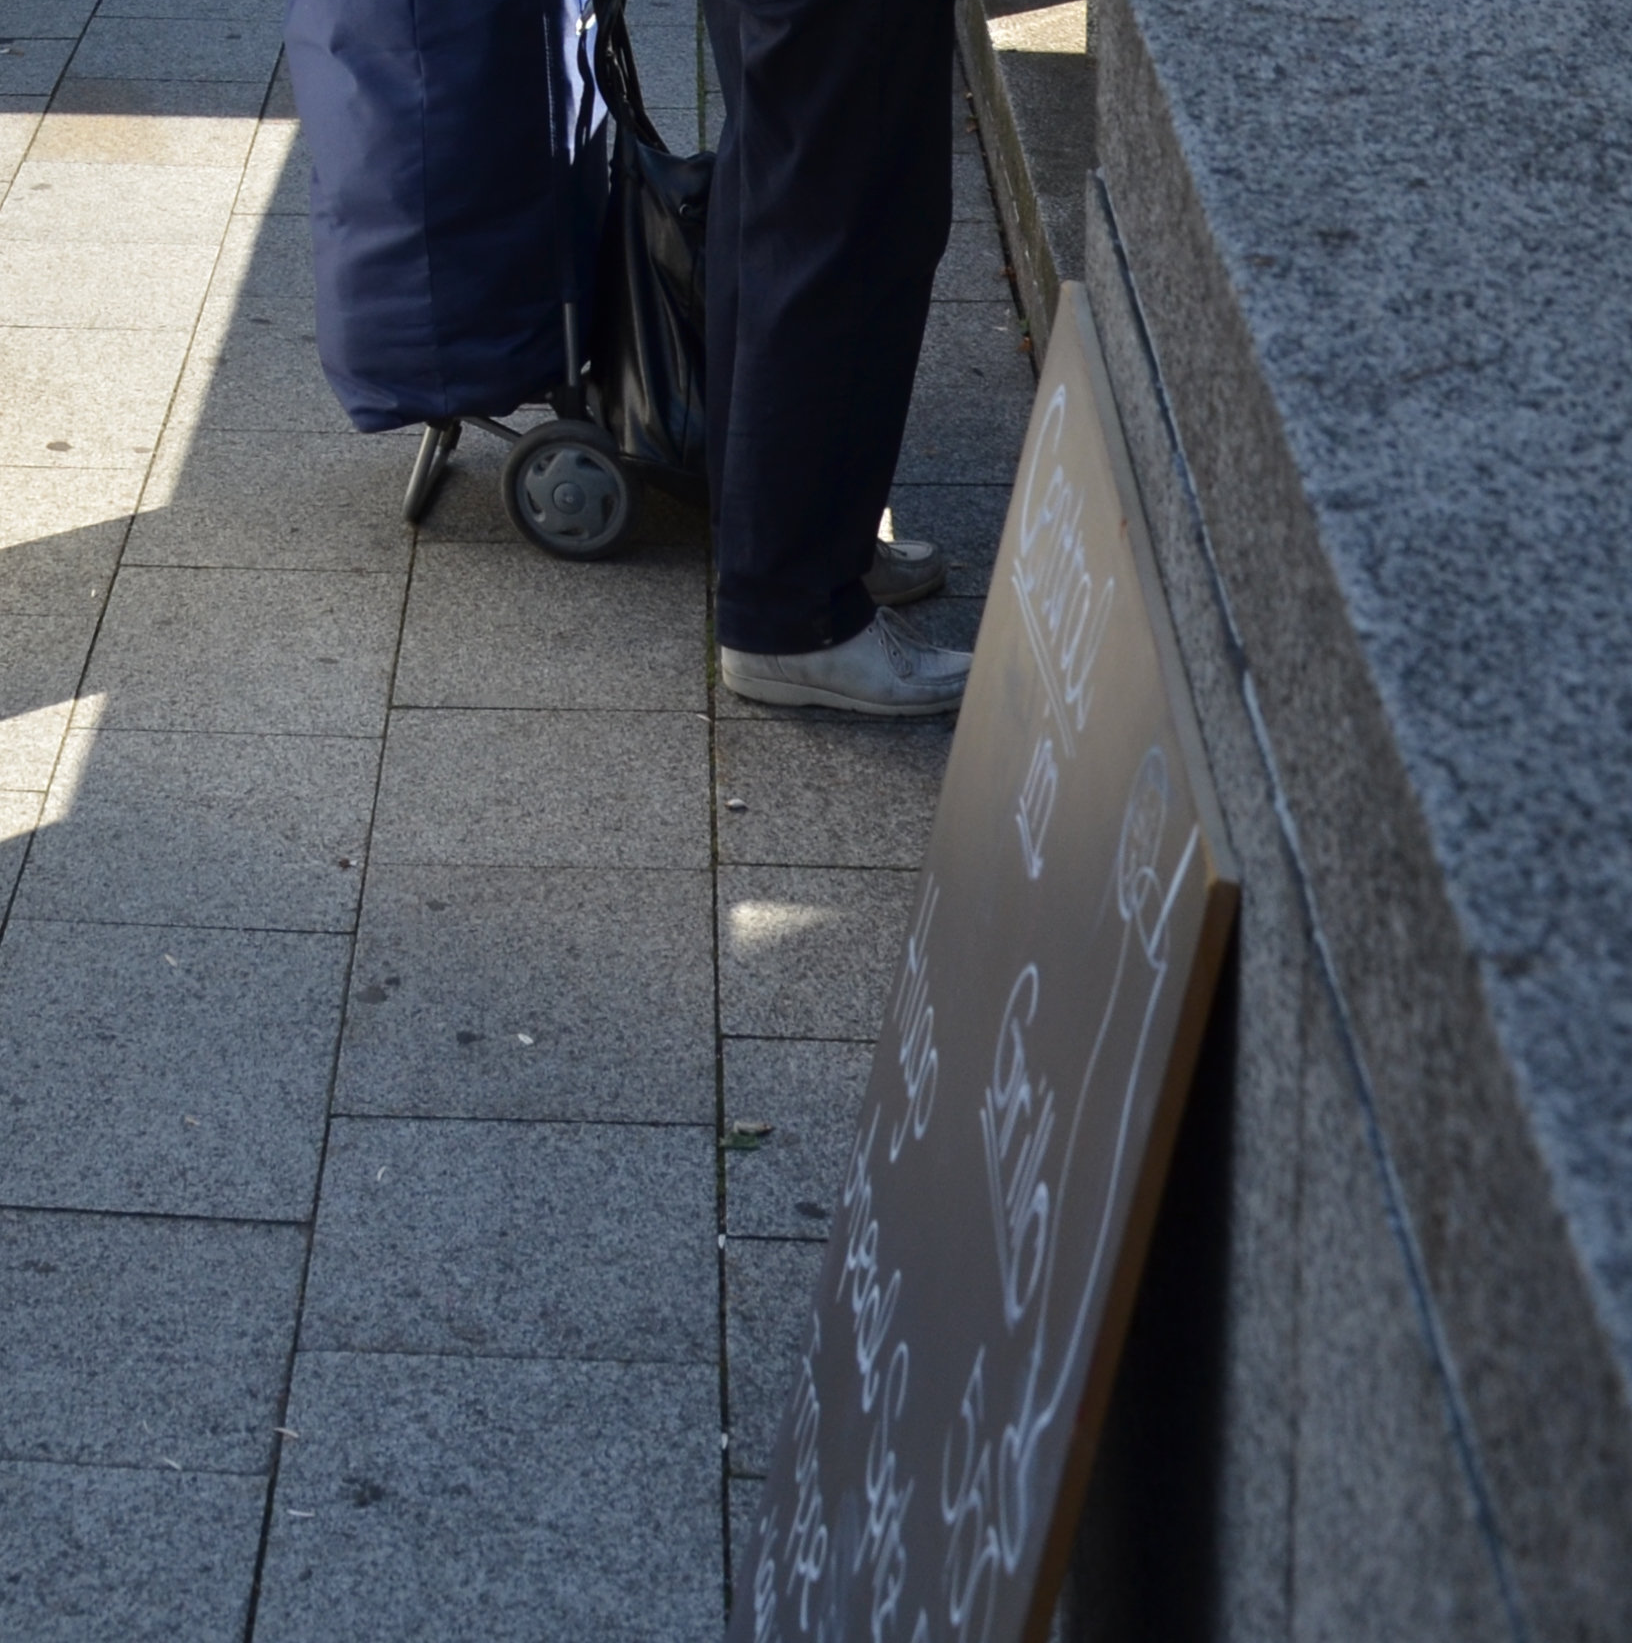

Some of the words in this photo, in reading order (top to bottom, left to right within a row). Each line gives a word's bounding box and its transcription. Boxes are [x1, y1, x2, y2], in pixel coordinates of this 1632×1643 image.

[1021, 383, 1114, 732] Central
[891, 872, 939, 1164] Hugo
[993, 963, 1054, 1317] Grillo
